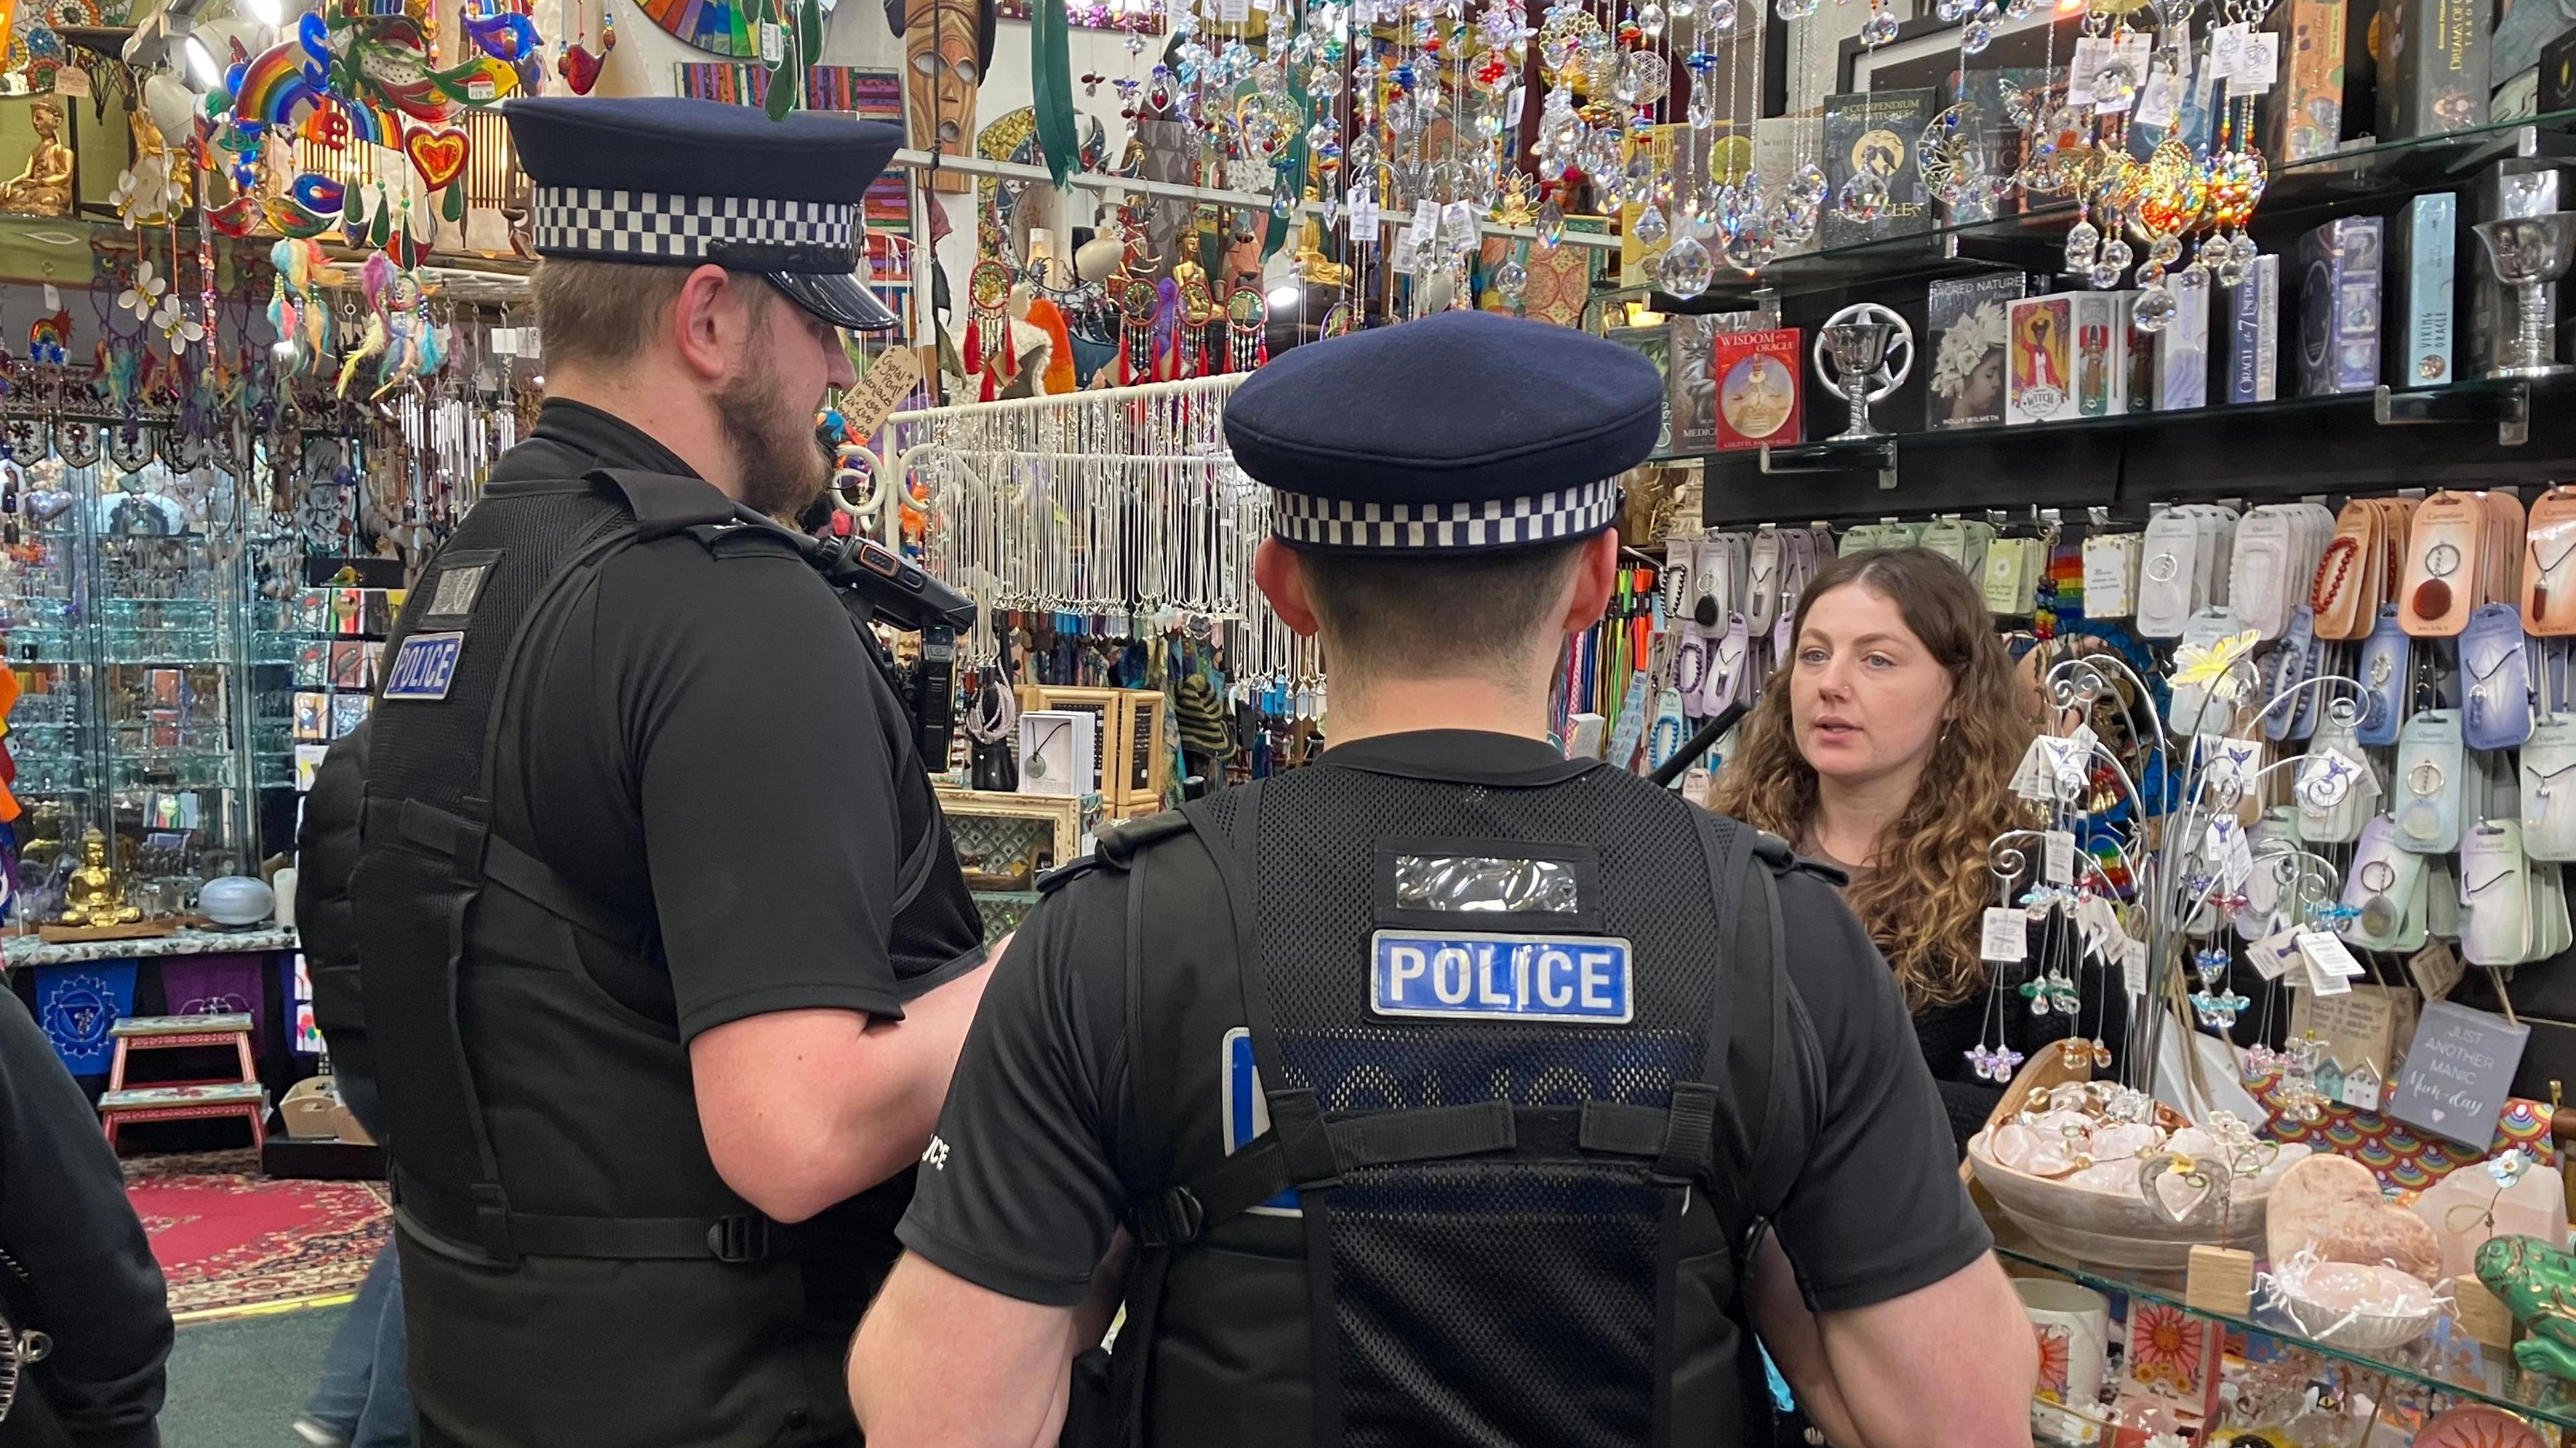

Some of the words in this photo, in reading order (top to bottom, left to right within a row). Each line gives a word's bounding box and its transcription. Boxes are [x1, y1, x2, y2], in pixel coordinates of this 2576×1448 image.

[1931, 283, 1975, 298] SACRED
[1976, 276, 2023, 292] NATURE
[1721, 333, 1775, 347] WISDOM
[2420, 313, 2432, 349] VIKING
[2432, 311, 2448, 348] ORACLE
[1756, 341, 1794, 352] ORACLE
[879, 355, 907, 382] Crystal
[390, 644, 455, 688] POLICE
[1390, 946, 1611, 1009] POLICE
[2448, 1026, 2484, 1044] JUST
[2425, 1038, 2495, 1070] ANOTHER
[2430, 1059, 2477, 1085] MANIC
